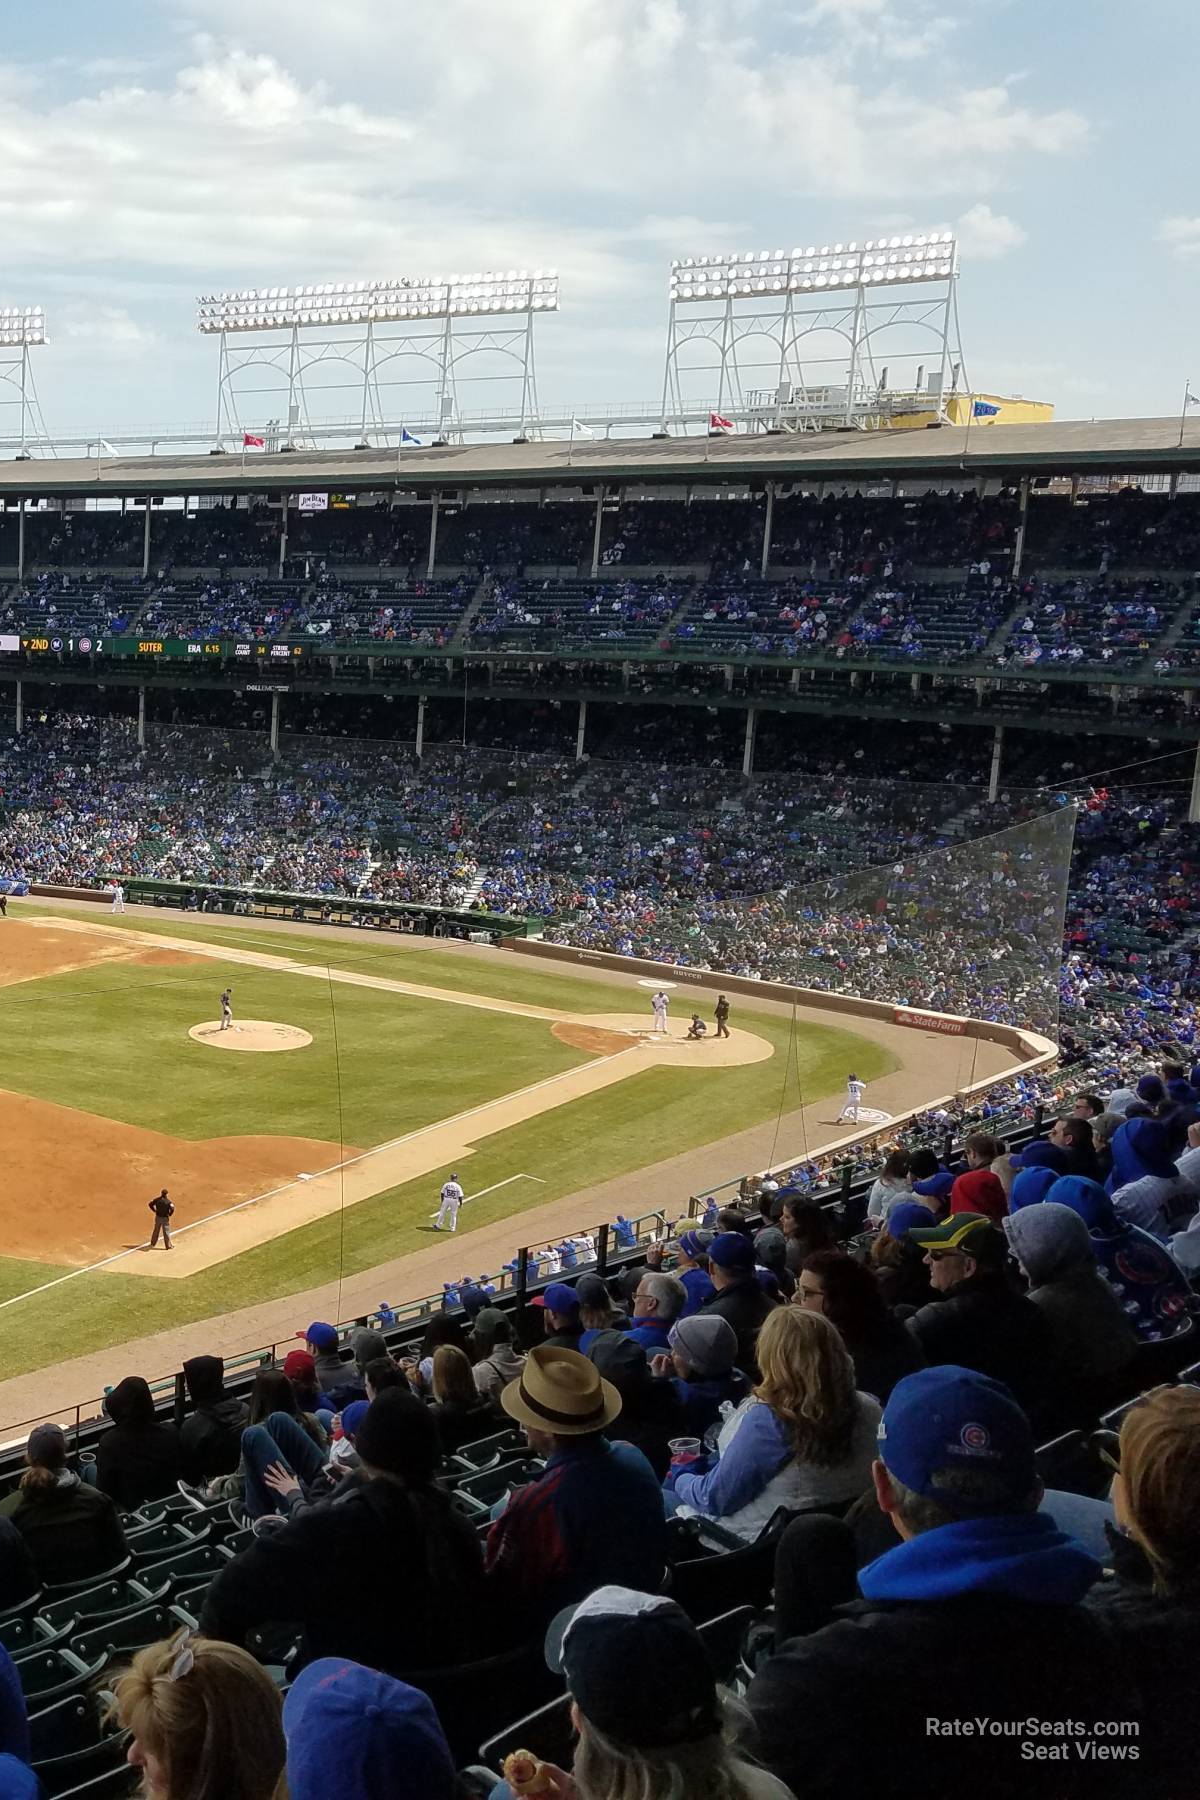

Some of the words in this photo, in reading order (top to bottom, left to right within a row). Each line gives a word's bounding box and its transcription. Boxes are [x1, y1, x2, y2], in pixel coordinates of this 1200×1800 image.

[31, 639, 49, 649] 2ND
[68, 639, 73, 651] 1
[96, 641, 102, 651] 2
[139, 643, 162, 652] SUTER
[188, 645, 201, 653] ERA
[673, 970, 702, 979] nuveen
